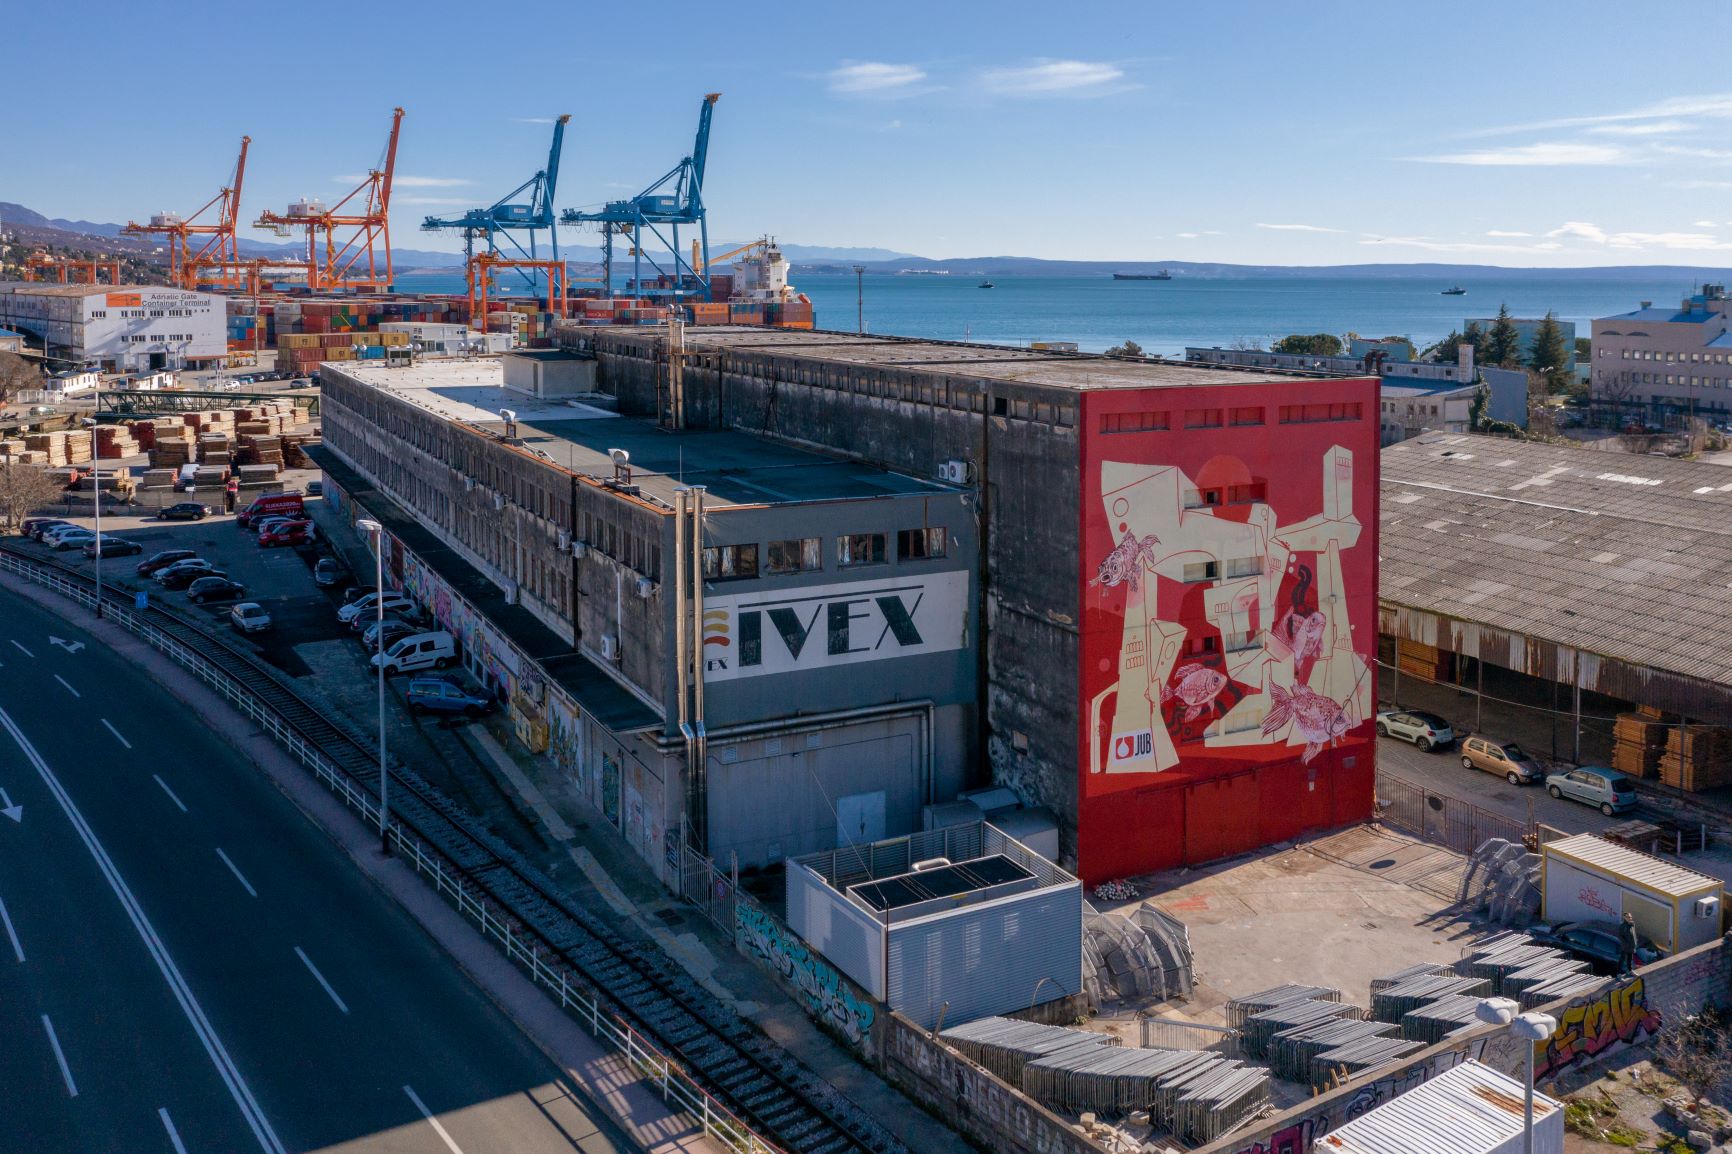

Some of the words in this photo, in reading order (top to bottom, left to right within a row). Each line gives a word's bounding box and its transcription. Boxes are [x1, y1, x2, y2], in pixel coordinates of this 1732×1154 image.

[142, 300, 177, 308] Container
[738, 592, 924, 667] IVEX
[1135, 733, 1152, 756] JUB
